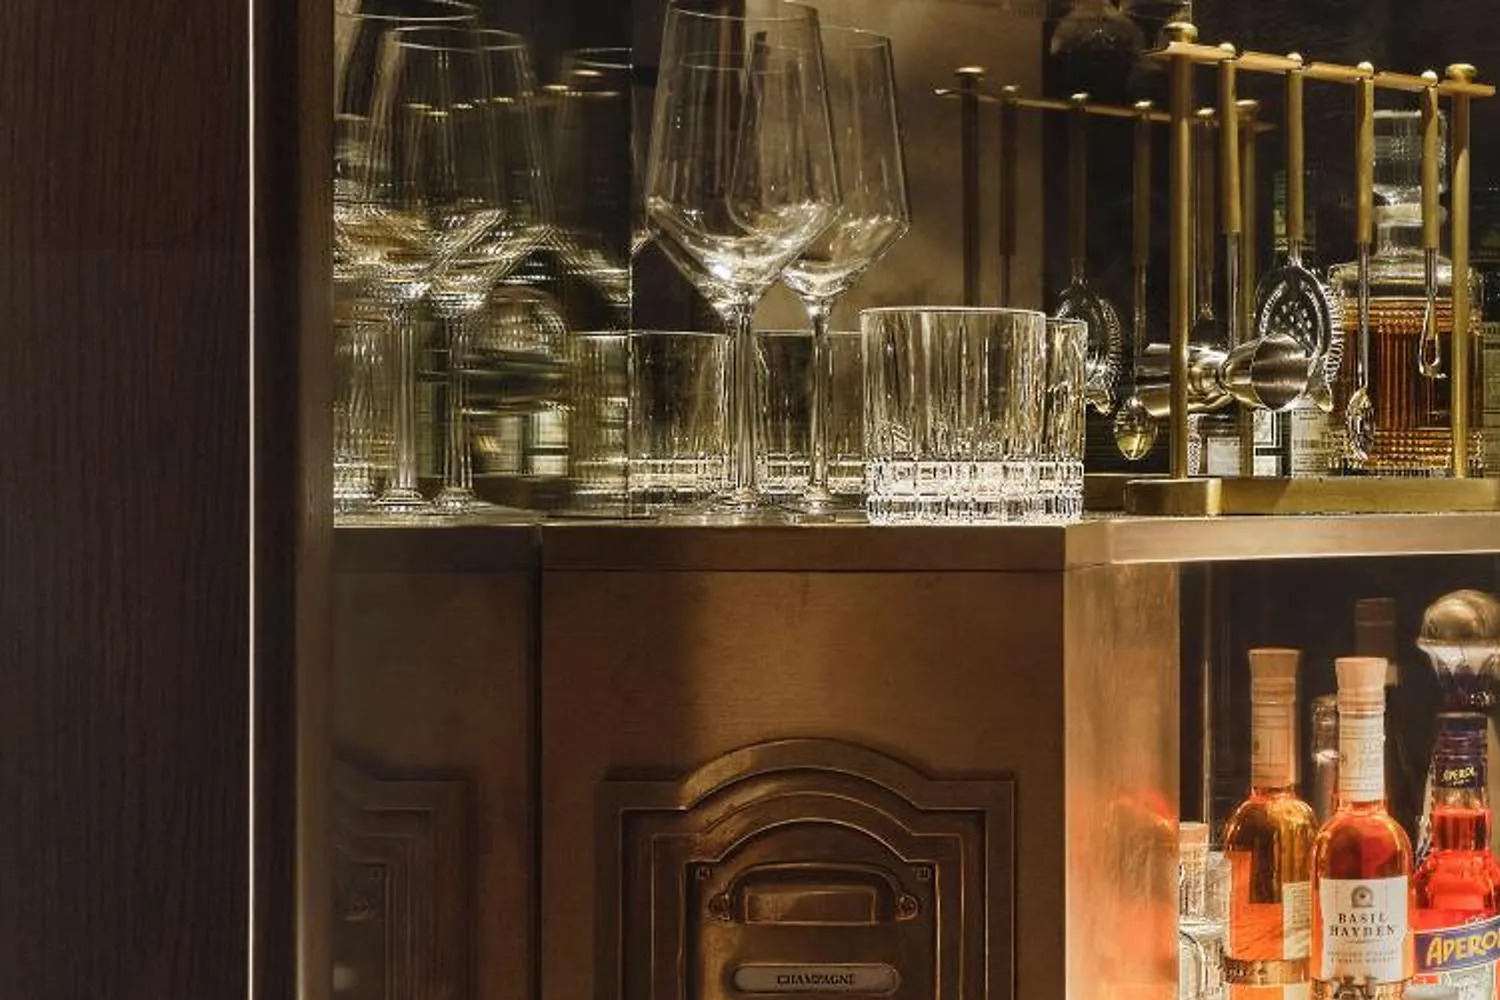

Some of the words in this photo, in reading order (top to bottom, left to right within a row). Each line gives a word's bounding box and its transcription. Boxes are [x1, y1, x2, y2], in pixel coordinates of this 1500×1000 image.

[1338, 913, 1388, 924] BASIL
[1328, 924, 1395, 937] HAYDEN
[776, 974, 856, 986] CHAMPAGNE
